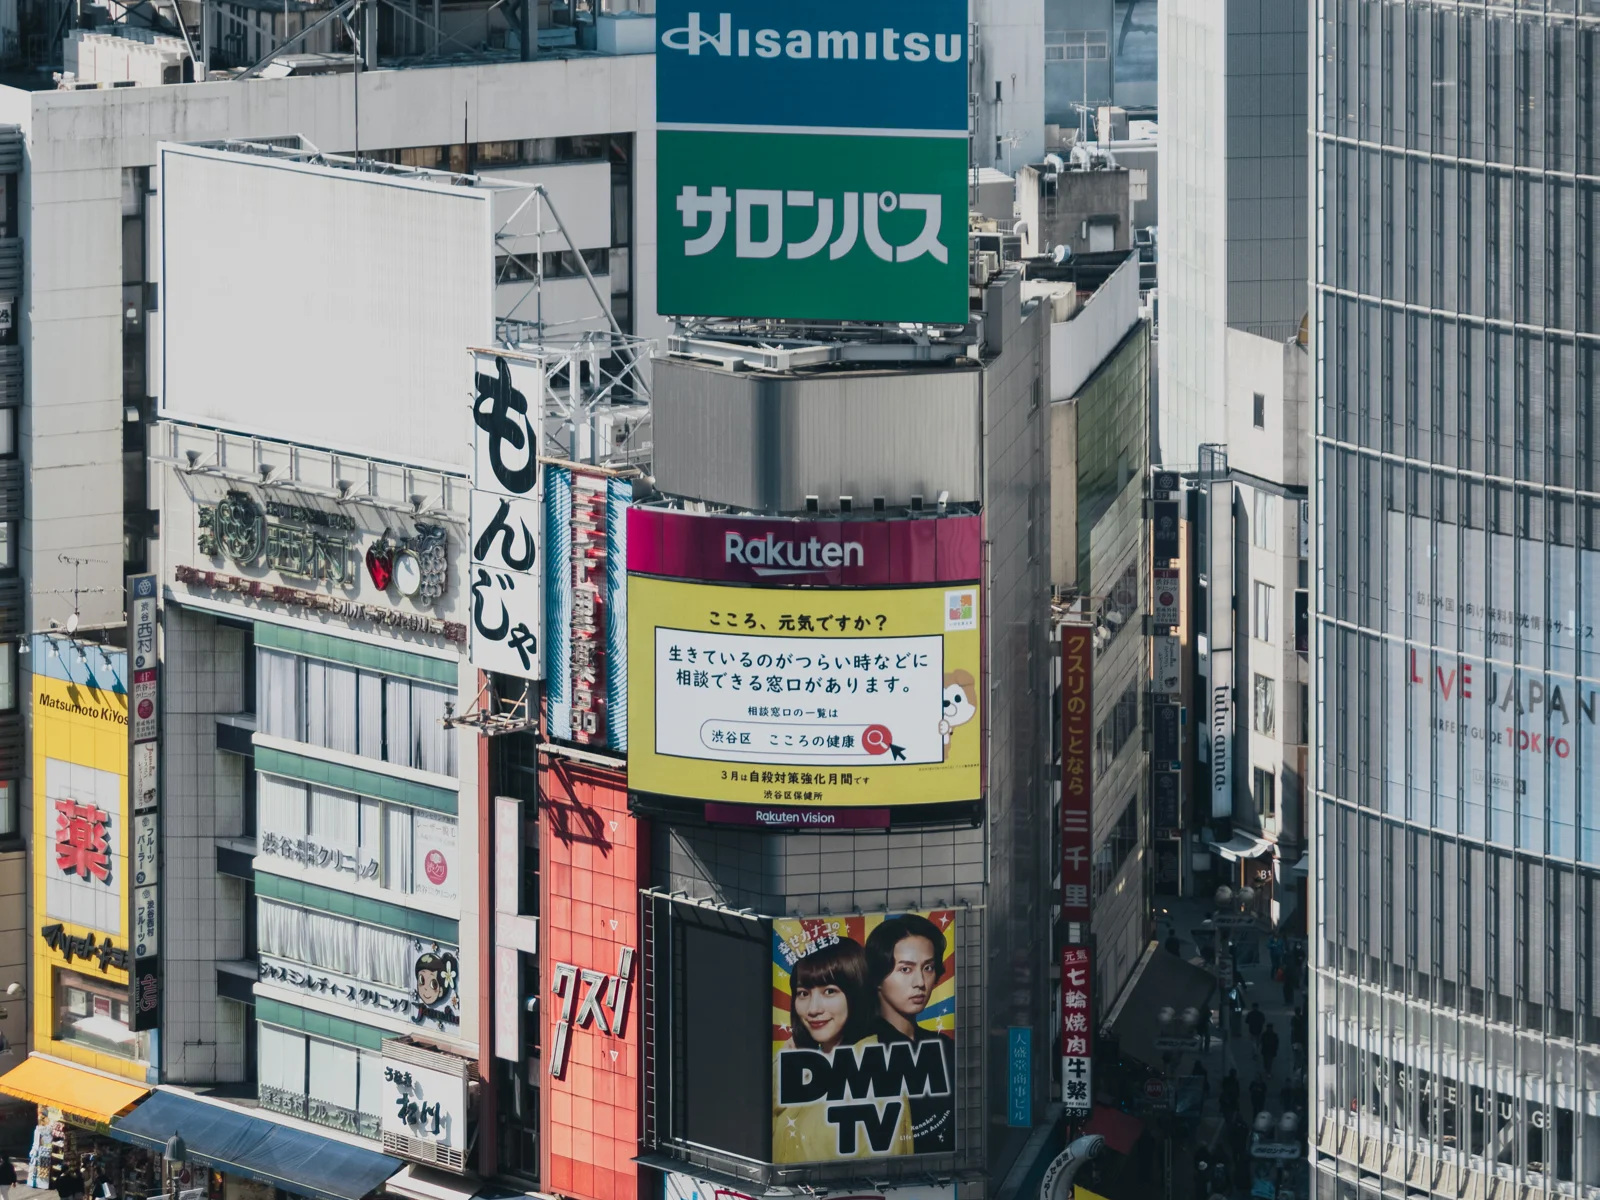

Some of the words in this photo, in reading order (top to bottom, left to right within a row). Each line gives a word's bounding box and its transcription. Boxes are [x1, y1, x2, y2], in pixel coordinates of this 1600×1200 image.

[661, 12, 962, 63] Hisamitsu
[676, 186, 949, 265] サロンパス
[473, 356, 537, 671] もんじゃ
[724, 533, 865, 570] Rakuten
[668, 645, 928, 670] 生きているのがつらい時などに
[676, 668, 912, 694] 相談できる窓口があります。
[1488, 671, 1597, 725] JAPAN
[39, 693, 99, 719] Matsumoto
[748, 706, 838, 719] 相談窓口の一覧は
[1068, 636, 1086, 795] クスリのことなら
[711, 730, 752, 745] 渋谷区
[769, 733, 855, 749] こころの健康
[721, 770, 870, 786] 3月は自殺対策強化月間です
[764, 790, 823, 801] 渋谷区保健所
[756, 810, 799, 823] Rakuten
[801, 812, 835, 823] Vision
[55, 798, 109, 886] 薬
[137, 835, 146, 870] パーラー
[147, 828, 155, 863] フルーツ
[1064, 810, 1089, 908] 三千里
[137, 907, 146, 942] フルーツ
[778, 921, 840, 955] 幸せカナコの
[784, 933, 840, 967] 殺し屋生活
[549, 947, 635, 1077] クスリ
[1064, 968, 1087, 1055] 七輪焼肉
[780, 1040, 949, 1105] DMM
[1067, 1058, 1087, 1100] 牛繁
[828, 1102, 901, 1154] TV
